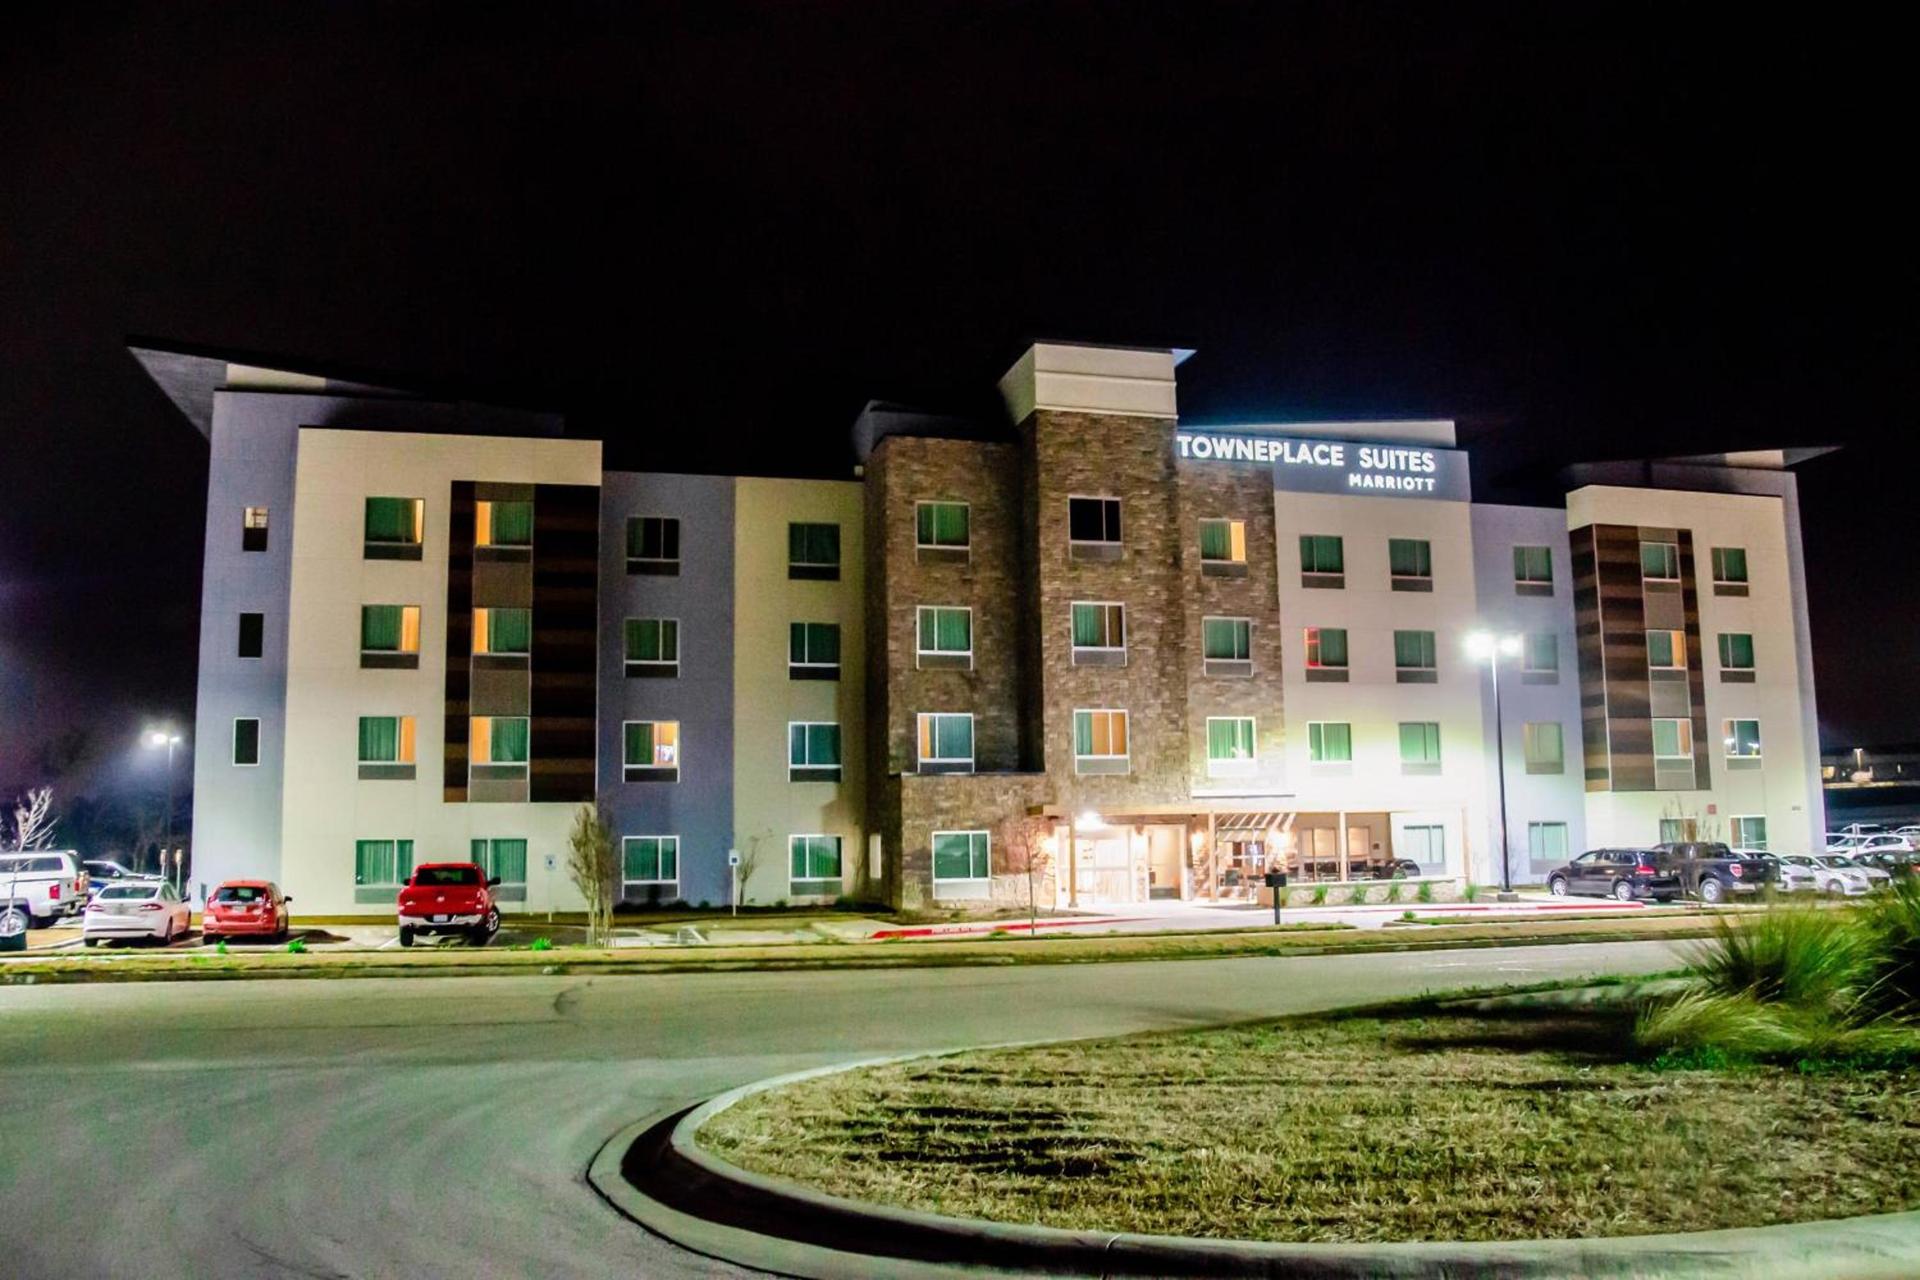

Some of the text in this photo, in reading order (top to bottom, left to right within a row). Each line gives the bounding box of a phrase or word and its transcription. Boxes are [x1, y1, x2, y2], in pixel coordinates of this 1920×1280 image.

[1176, 435, 1436, 473] TOWNEPLACE SUITES
[1348, 472, 1435, 491] MARRIOTT
